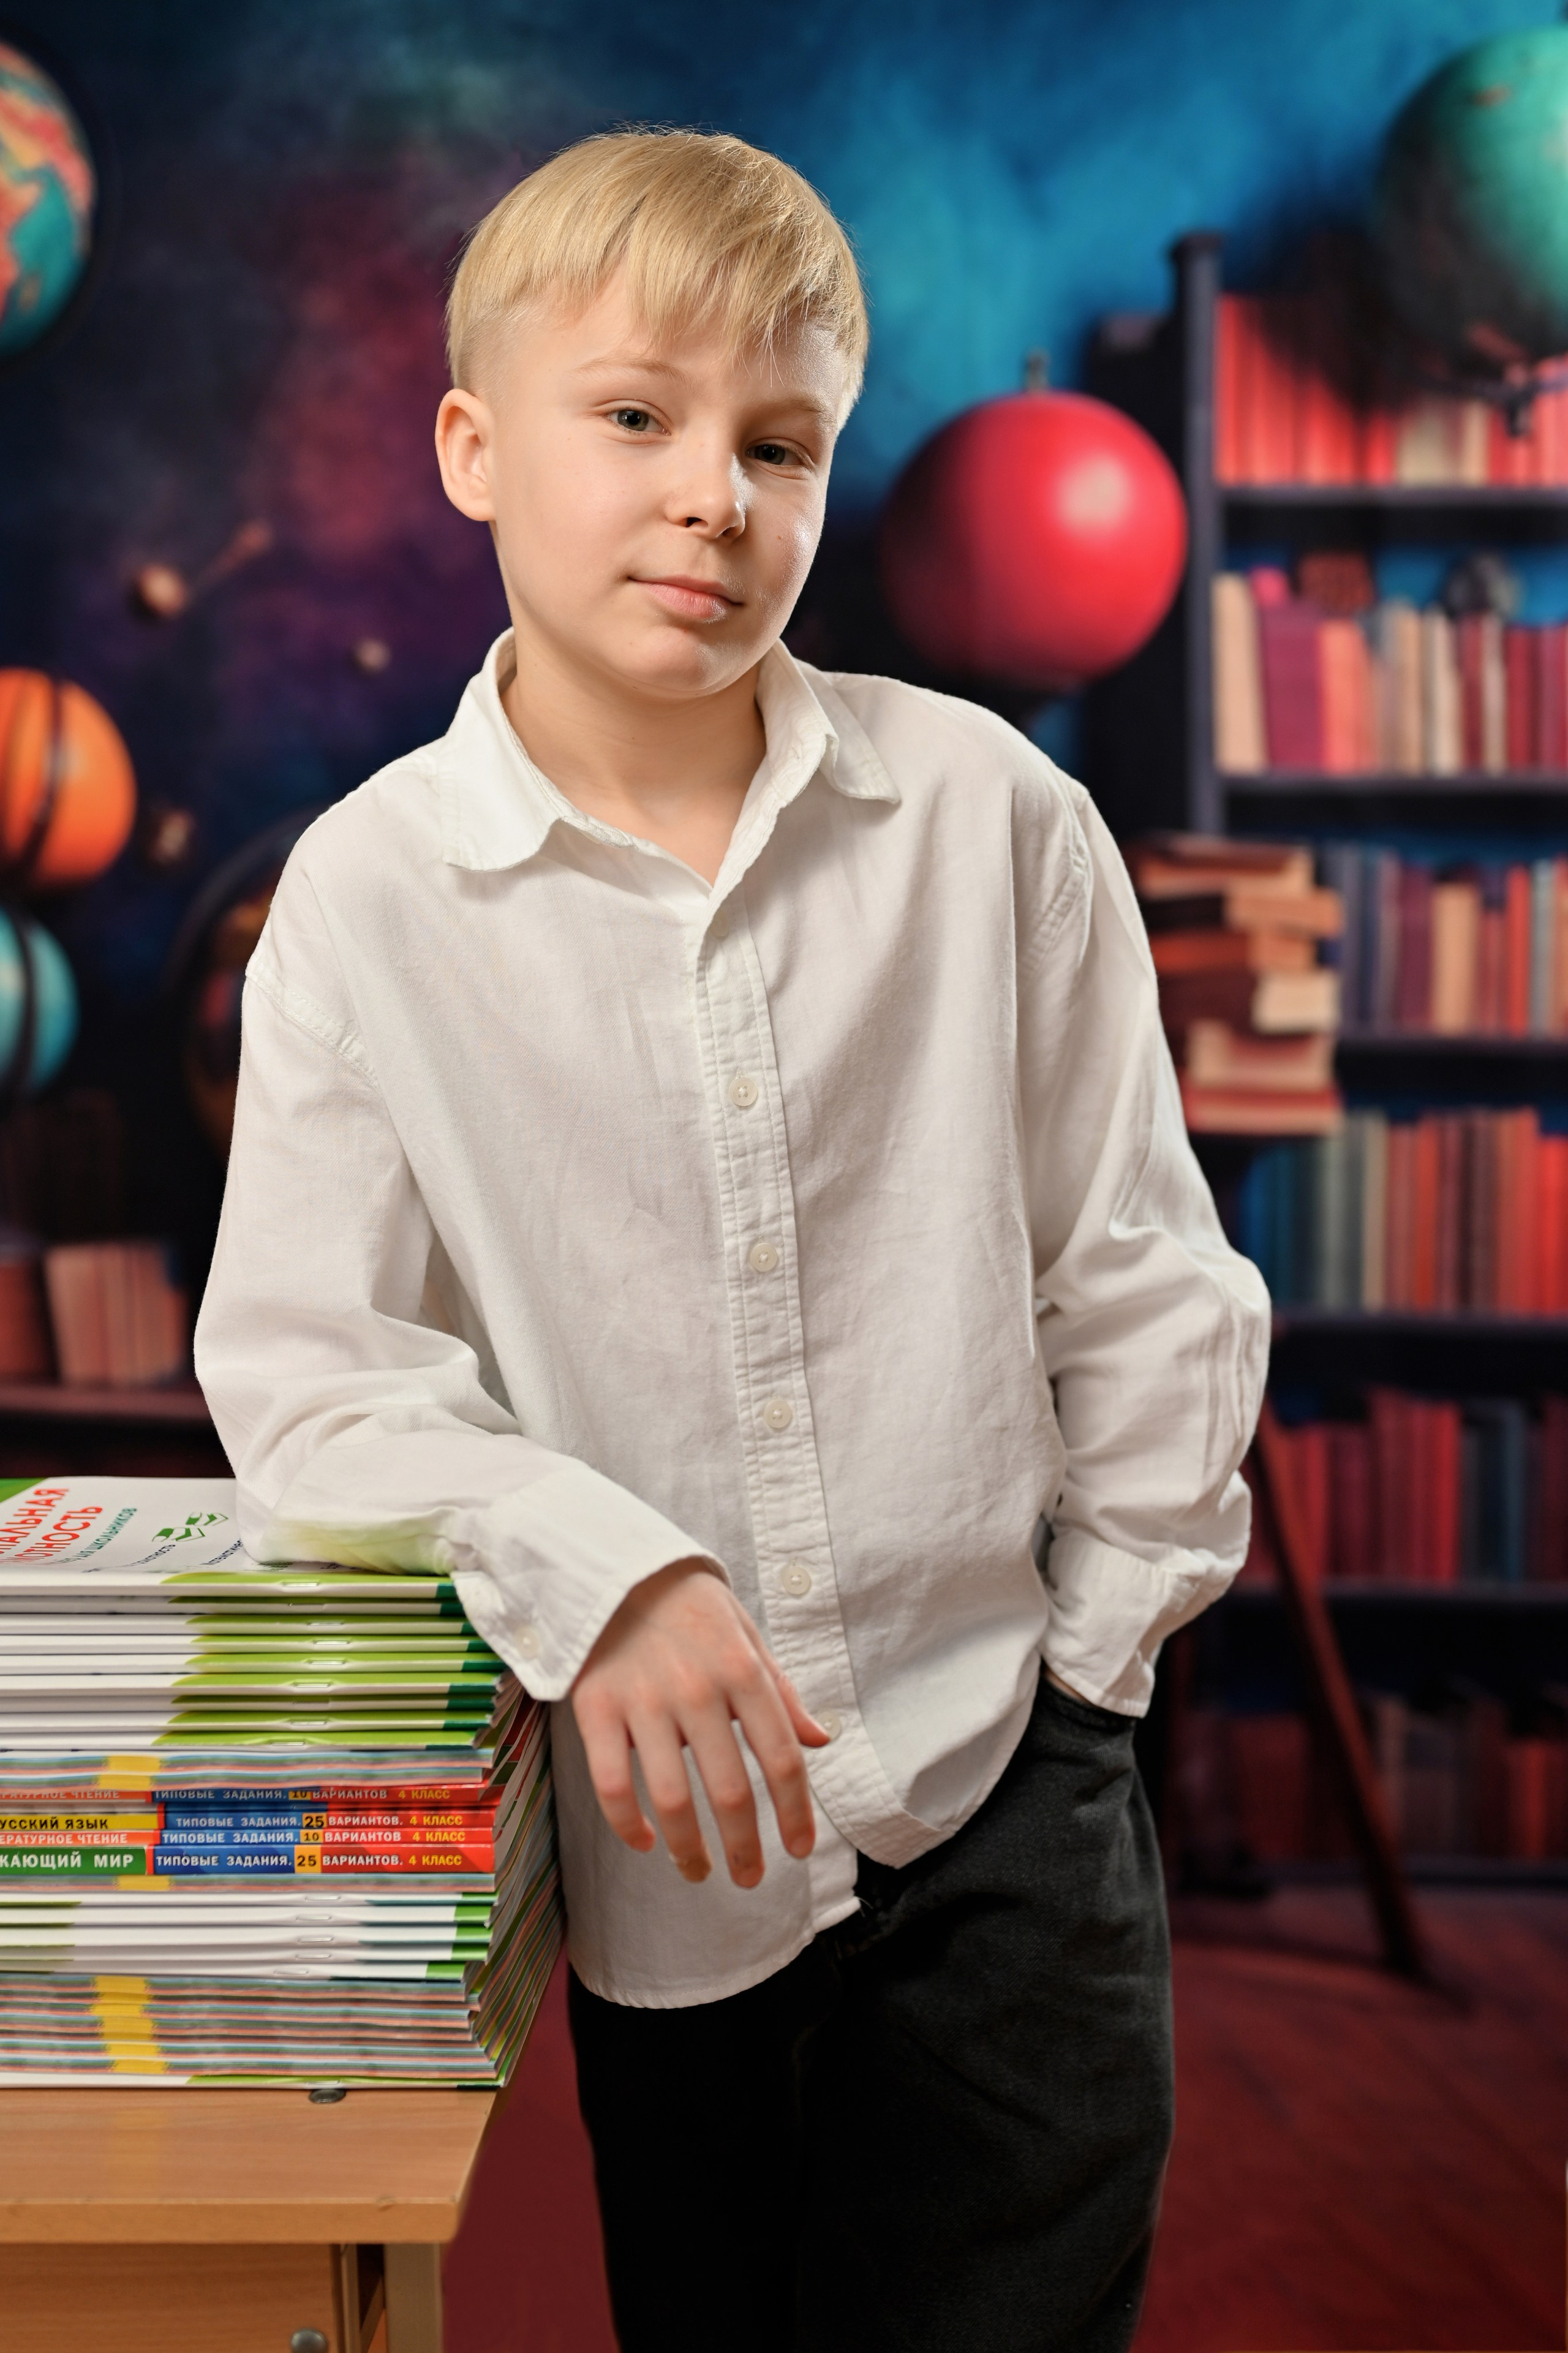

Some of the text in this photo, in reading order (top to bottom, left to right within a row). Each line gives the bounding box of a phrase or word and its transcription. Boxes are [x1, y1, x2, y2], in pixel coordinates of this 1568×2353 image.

[0, 1488, 69, 1554] АЛЬНАЯ
[85, 1508, 137, 1550] ШКОЛЬНИКОВ
[154, 1790, 216, 1799] ТИПОВЫЕ
[292, 1790, 307, 1799] 10
[312, 1789, 388, 1799] ВАРИАНТОВ
[398, 1789, 406, 1799] 4
[411, 1789, 451, 1799] КЛАСС
[65, 1819, 108, 1829] ЯЗЫК
[176, 1817, 234, 1827] ТИПОВЫЕ
[241, 1816, 301, 1828] ЗАДАНИЯ.
[304, 1816, 325, 1828] 25
[328, 1816, 404, 1827] ВАРИАНТОВ.
[409, 1816, 418, 1826] 4
[423, 1815, 464, 1826] КЛАСС
[78, 1833, 128, 1844] ЧТЕНИЕ
[162, 1833, 225, 1843] ТИПОВЫЕ
[233, 1832, 298, 1844] ЗАДАНИЯ.
[303, 1832, 320, 1842] 10
[324, 1832, 401, 1842] ВАРИАНТОВ
[412, 1832, 420, 1841] 4
[426, 1832, 466, 1841] КЛАСС
[94, 1854, 134, 1868] МИР
[156, 1855, 219, 1867] ТИПОВЫЕ
[226, 1855, 292, 1868] ЗАДАНИЯ.
[296, 1855, 317, 1867] 25
[322, 1855, 403, 1866] ВАРИАНТОВ.
[409, 1855, 417, 1865] 4
[421, 1855, 462, 1865] КЛАСС
